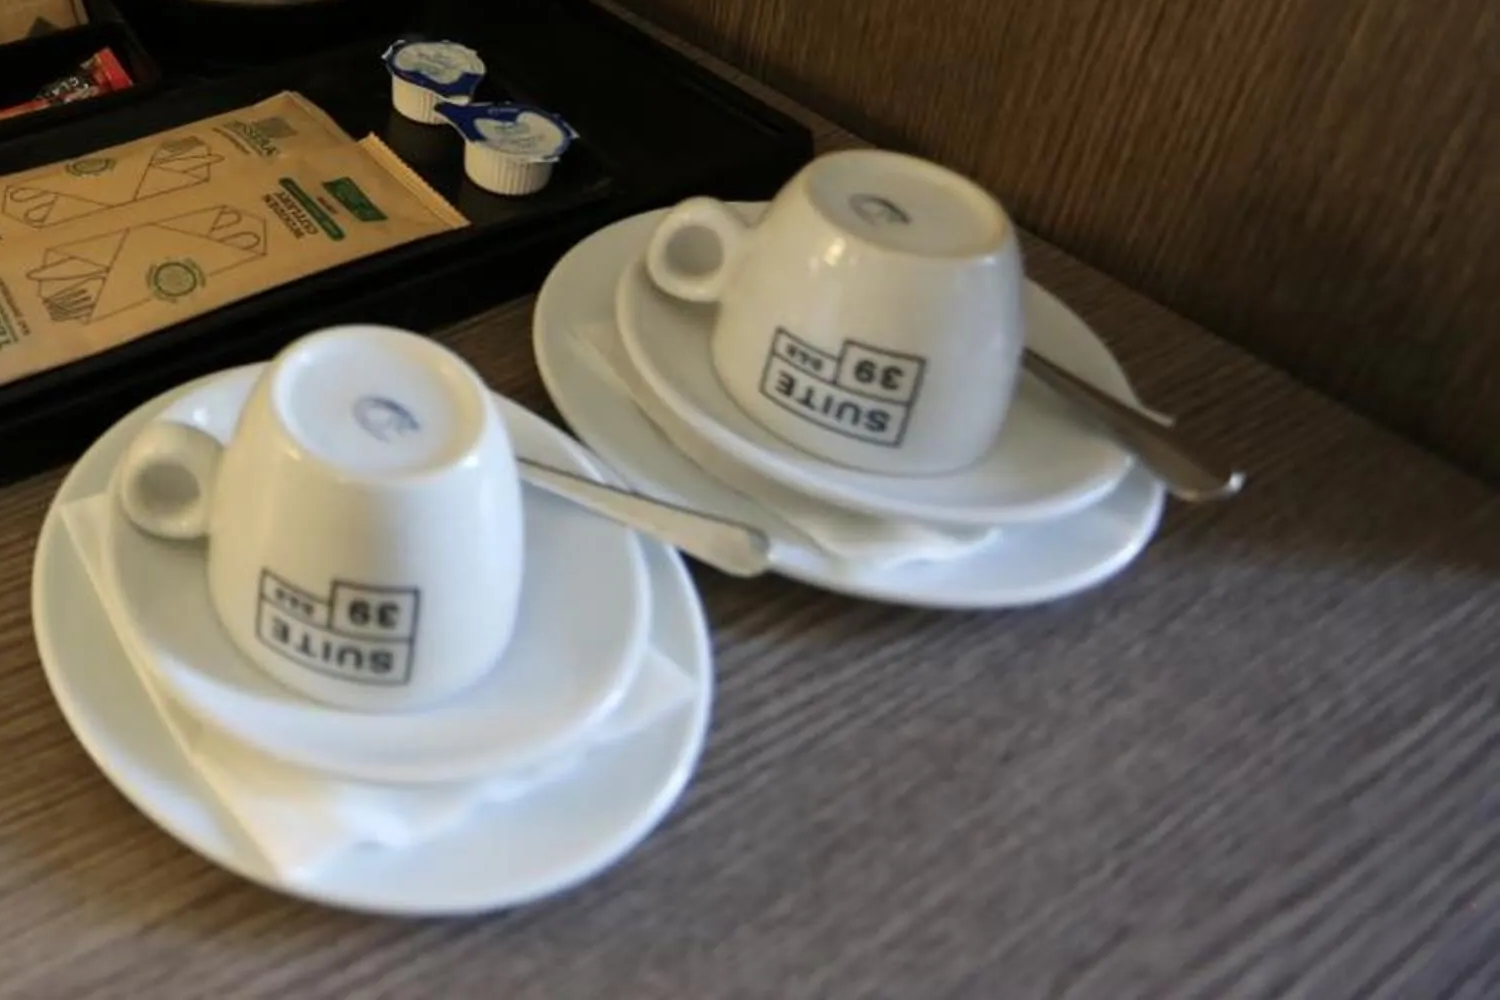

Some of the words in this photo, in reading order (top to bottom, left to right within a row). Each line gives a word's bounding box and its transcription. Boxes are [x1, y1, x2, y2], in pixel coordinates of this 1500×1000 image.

[854, 359, 904, 391] 39
[774, 370, 892, 433] SUITE
[347, 595, 399, 629] 39
[271, 615, 394, 674] SUITE
